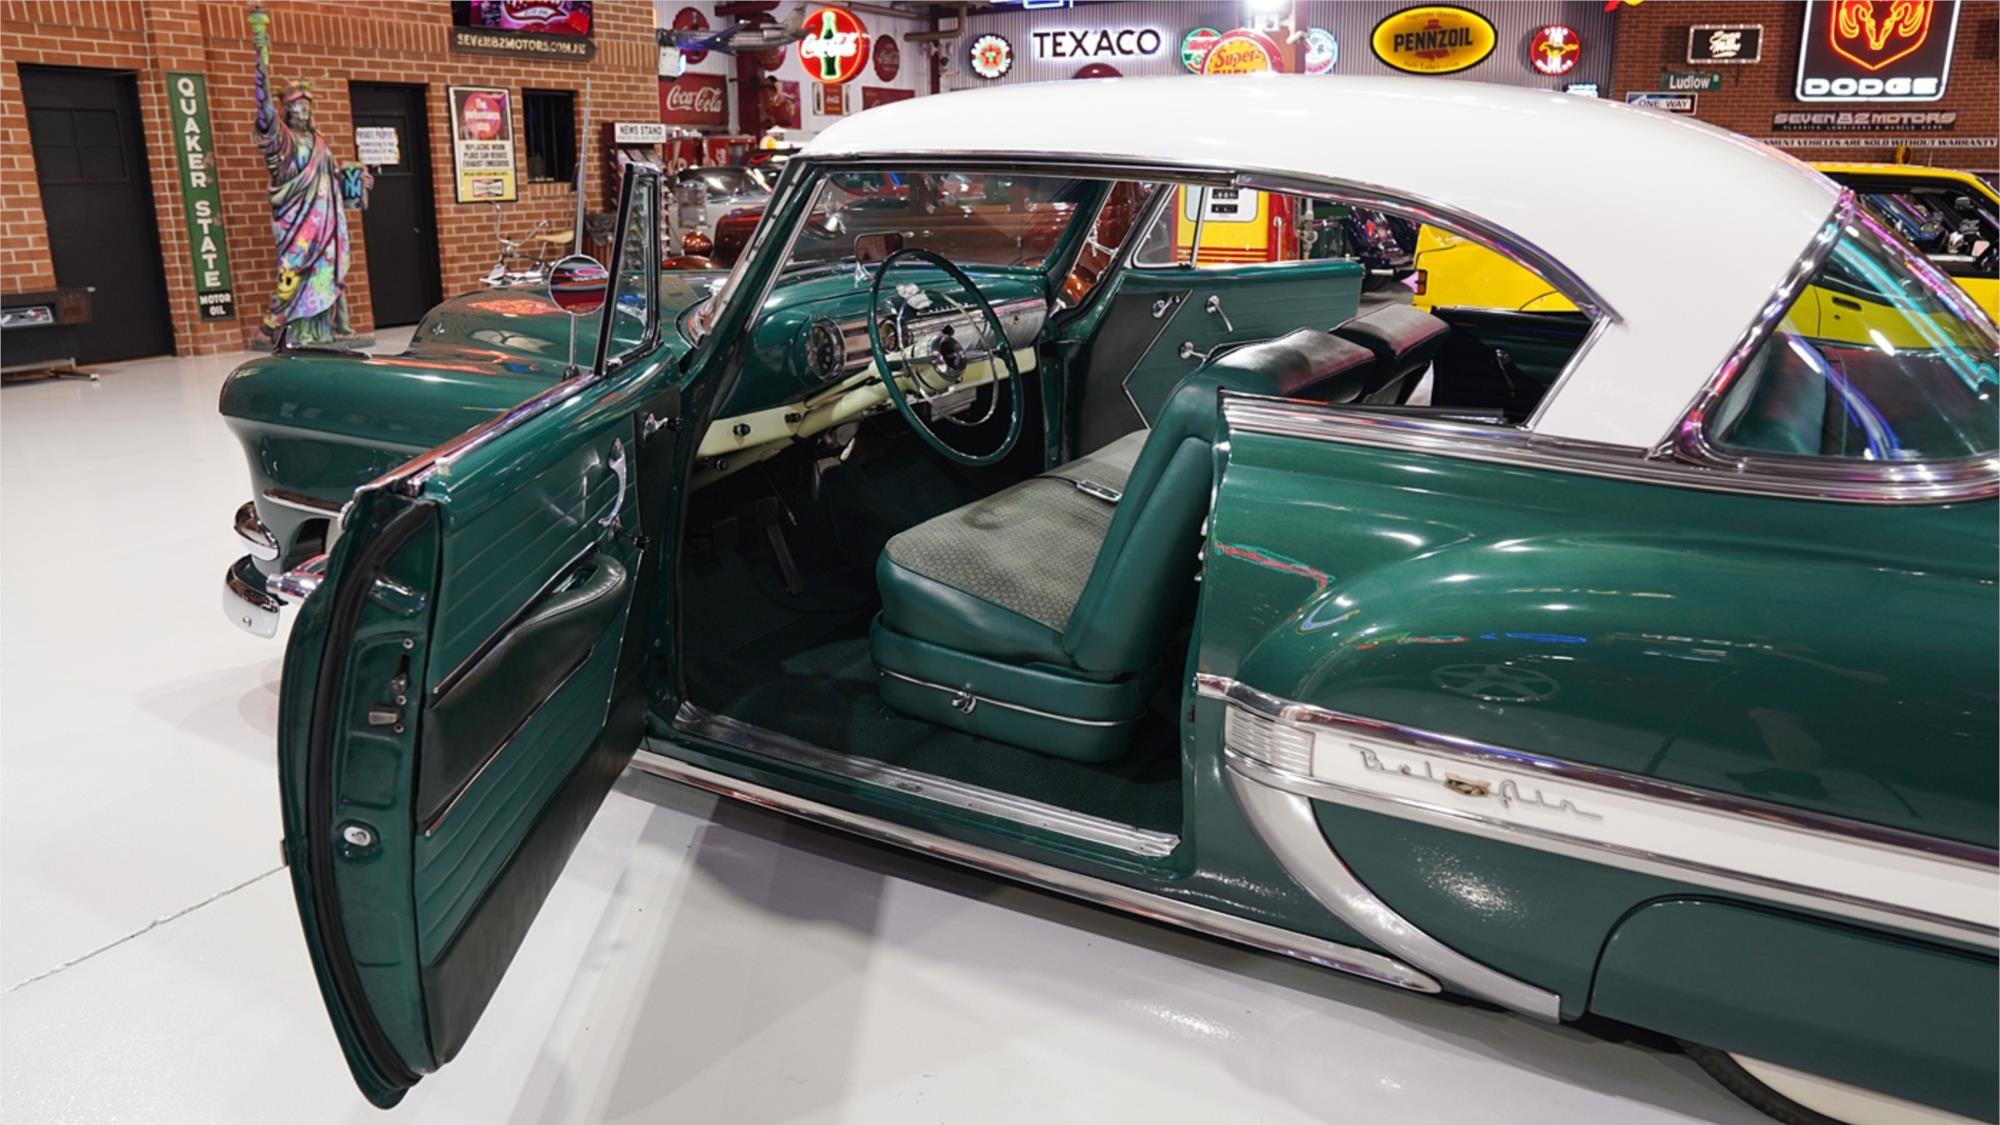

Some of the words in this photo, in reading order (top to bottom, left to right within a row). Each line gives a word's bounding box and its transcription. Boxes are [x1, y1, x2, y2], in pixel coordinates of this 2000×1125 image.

[1033, 29, 1161, 58] TEXACO
[1394, 27, 1473, 52] PENNZOIL
[1669, 75, 1711, 89] Ludlow
[1804, 77, 1938, 95] DODGE
[666, 84, 722, 113] Coca-Cola
[1638, 99, 1658, 110] ONE
[1666, 99, 1688, 109] WAY
[1774, 113, 1835, 124] SEVEN
[1871, 112, 1957, 124] MOTORS
[620, 127, 639, 135] NEWS
[641, 127, 662, 135] STAND
[177, 77, 207, 188] QUAKER
[195, 200, 222, 288] STATE
[199, 293, 232, 305] MOTOR
[209, 305, 227, 316] OIL
[1349, 742, 1446, 782] Bel
[1490, 779, 1603, 821] Air
